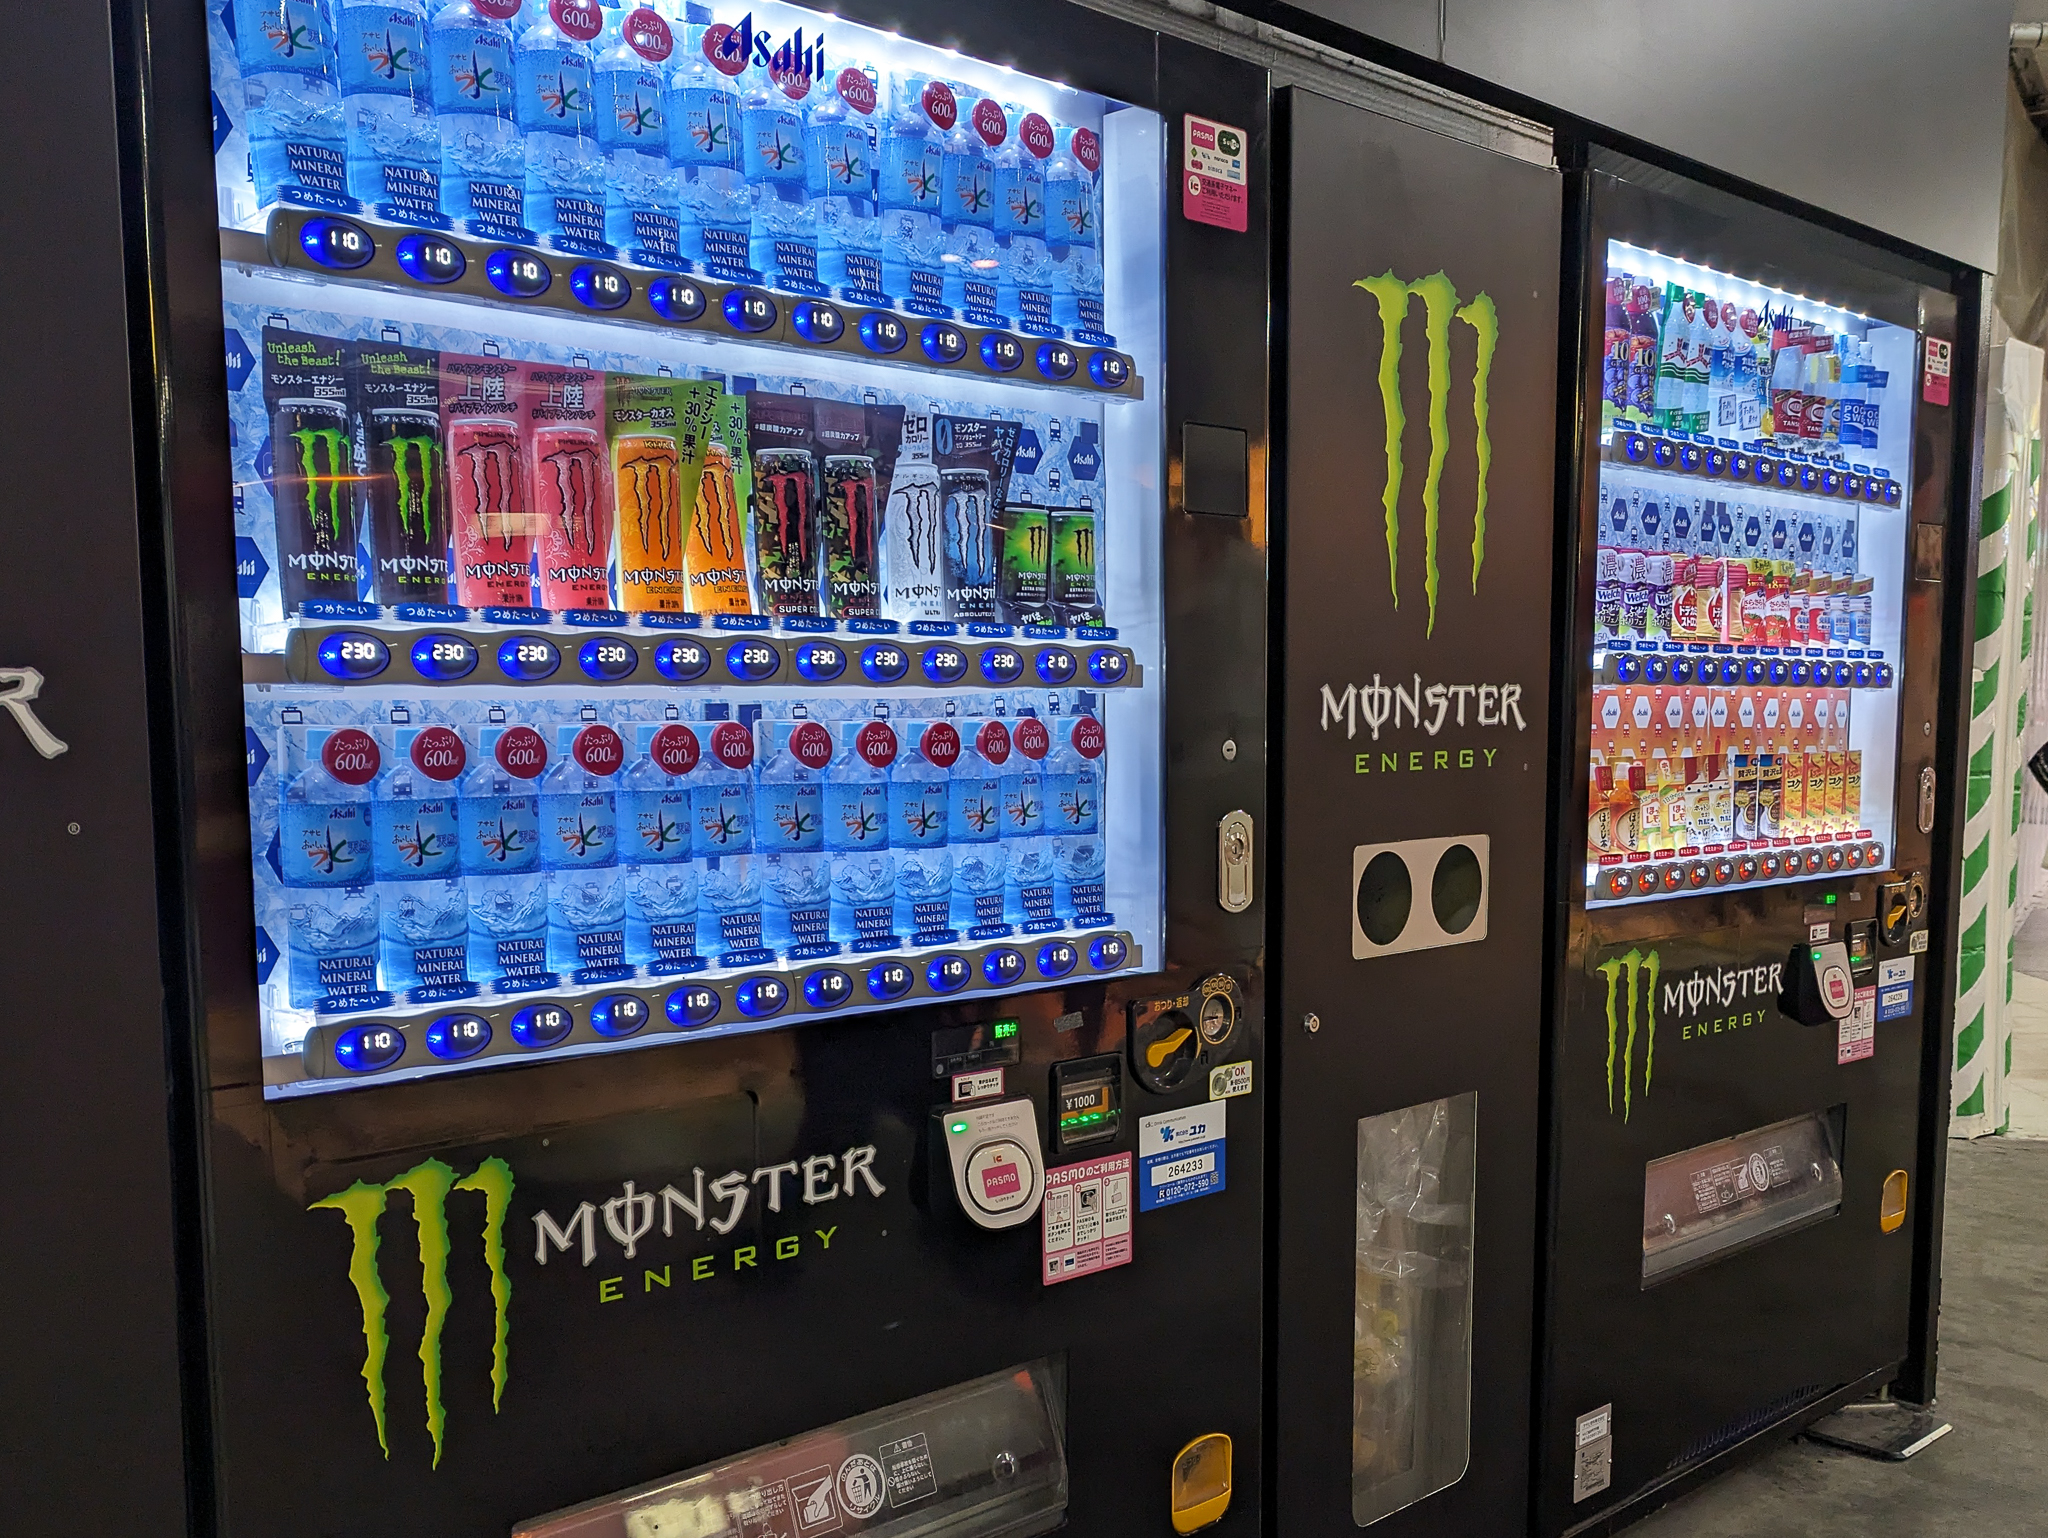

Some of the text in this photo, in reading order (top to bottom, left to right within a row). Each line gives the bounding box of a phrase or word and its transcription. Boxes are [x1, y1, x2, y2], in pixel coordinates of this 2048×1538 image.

[723, 12, 824, 82] Asahi
[1192, 129, 1214, 142] PASMO
[287, 144, 344, 164] NATURAL
[290, 159, 345, 178] MINERAL
[384, 166, 438, 186] NATURAL
[300, 173, 341, 191] WATER
[386, 181, 438, 200] MINERAL
[470, 182, 522, 199] NATURAL
[394, 196, 434, 212] WATER
[472, 198, 523, 215] MINERAL
[555, 198, 604, 217] NATURAL
[480, 212, 519, 227] WATER
[557, 213, 604, 229] MINERAL
[634, 212, 679, 229] NATURAL
[330, 230, 360, 251] 110
[565, 226, 601, 241] WATER
[636, 226, 679, 243] MINERAL
[704, 229, 747, 245] NATURAL
[643, 239, 677, 254] WATER
[705, 242, 748, 257] MINERAL
[776, 242, 816, 258] NATURAL
[425, 246, 451, 266] 110
[710, 255, 744, 268] WATER
[512, 261, 538, 280] 110
[594, 275, 619, 293] 110
[672, 288, 695, 306] 110
[744, 300, 766, 317] 110
[813, 311, 833, 328] 110
[877, 322, 897, 338] 110
[267, 341, 316, 354] Unleash
[939, 333, 957, 348] 110
[277, 349, 341, 366] the Beast!
[361, 351, 408, 364] Unleash
[997, 343, 1014, 357] 110
[371, 359, 431, 375] the Beast!
[1052, 352, 1069, 366] 110
[1102, 359, 1119, 374] 110
[270, 374, 344, 384] モンスターエナジー
[314, 387, 346, 397] 355ml
[364, 383, 435, 393] モンスターエナジー
[459, 375, 505, 401] 上陸
[407, 395, 437, 405] 355ml
[541, 384, 584, 409] 上陸
[614, 407, 675, 422] モンスターカオス
[904, 415, 927, 435] ゼロ
[955, 424, 986, 433] モンスター
[905, 435, 929, 443] カロリー
[1074, 453, 1094, 465] Asahi
[779, 605, 807, 614] SUPER
[848, 608, 874, 616] SUPER
[341, 641, 376, 660] 230
[432, 643, 465, 661] 230
[517, 645, 548, 662] 230
[597, 646, 626, 662] 230
[672, 647, 700, 664] 230
[743, 648, 769, 664] 230
[811, 649, 836, 665] 230
[874, 651, 899, 666] 230
[935, 653, 958, 667] 230
[993, 654, 1015, 668] 230
[1047, 655, 1068, 669] 210
[1099, 656, 1120, 670] 210
[1320, 673, 1526, 740] MONSTER
[334, 739, 369, 751] たっぷり
[422, 736, 455, 748] たっぷり
[1355, 749, 1497, 773] ENERGY
[419, 803, 443, 814] Asahi
[502, 800, 526, 813] Asahi
[580, 796, 604, 808] Asahi
[330, 807, 355, 819] Asahi
[721, 914, 761, 927] NATURAL
[578, 931, 623, 945] NATURAL
[652, 924, 696, 938] NATURAL
[723, 925, 761, 938] MINERAL
[498, 938, 545, 954] NATURAL
[652, 935, 695, 949] MINERAL
[1102, 942, 1119, 955] 110
[415, 946, 465, 962] NATURAL
[499, 952, 545, 966] MINERAL
[579, 944, 623, 958] MINERAL
[1052, 948, 1069, 962] 110
[319, 956, 373, 971] NATURAL
[416, 959, 465, 974] MINERAL
[944, 961, 962, 975] 110
[999, 954, 1017, 968] 110
[320, 968, 373, 984] MINERAL
[423, 972, 461, 985] WATER
[506, 965, 541, 976] WATER
[884, 968, 904, 983] 110
[328, 984, 368, 996] WATER
[822, 975, 843, 990] 110
[1663, 963, 1784, 1017] MONSTER
[757, 983, 778, 999] 110
[687, 992, 709, 1008] 110
[614, 1001, 637, 1017] 110
[535, 1011, 560, 1028] 110
[1682, 1009, 1766, 1040] ENERGY
[453, 1021, 479, 1038] 110
[995, 1022, 1017, 1038] 販売中
[363, 1032, 391, 1050] 110
[1235, 1067, 1245, 1076] OK
[1066, 1094, 1095, 1110] ¥1000
[1189, 1124, 1206, 1136] ユカ
[1168, 1159, 1203, 1177] 264233
[986, 1172, 1016, 1188] PASMO
[531, 1145, 885, 1266] MONSTER
[599, 1226, 837, 1303] ENERGY
[841, 1458, 877, 1482] のんだあとは
[849, 1494, 880, 1515] リサイクル
